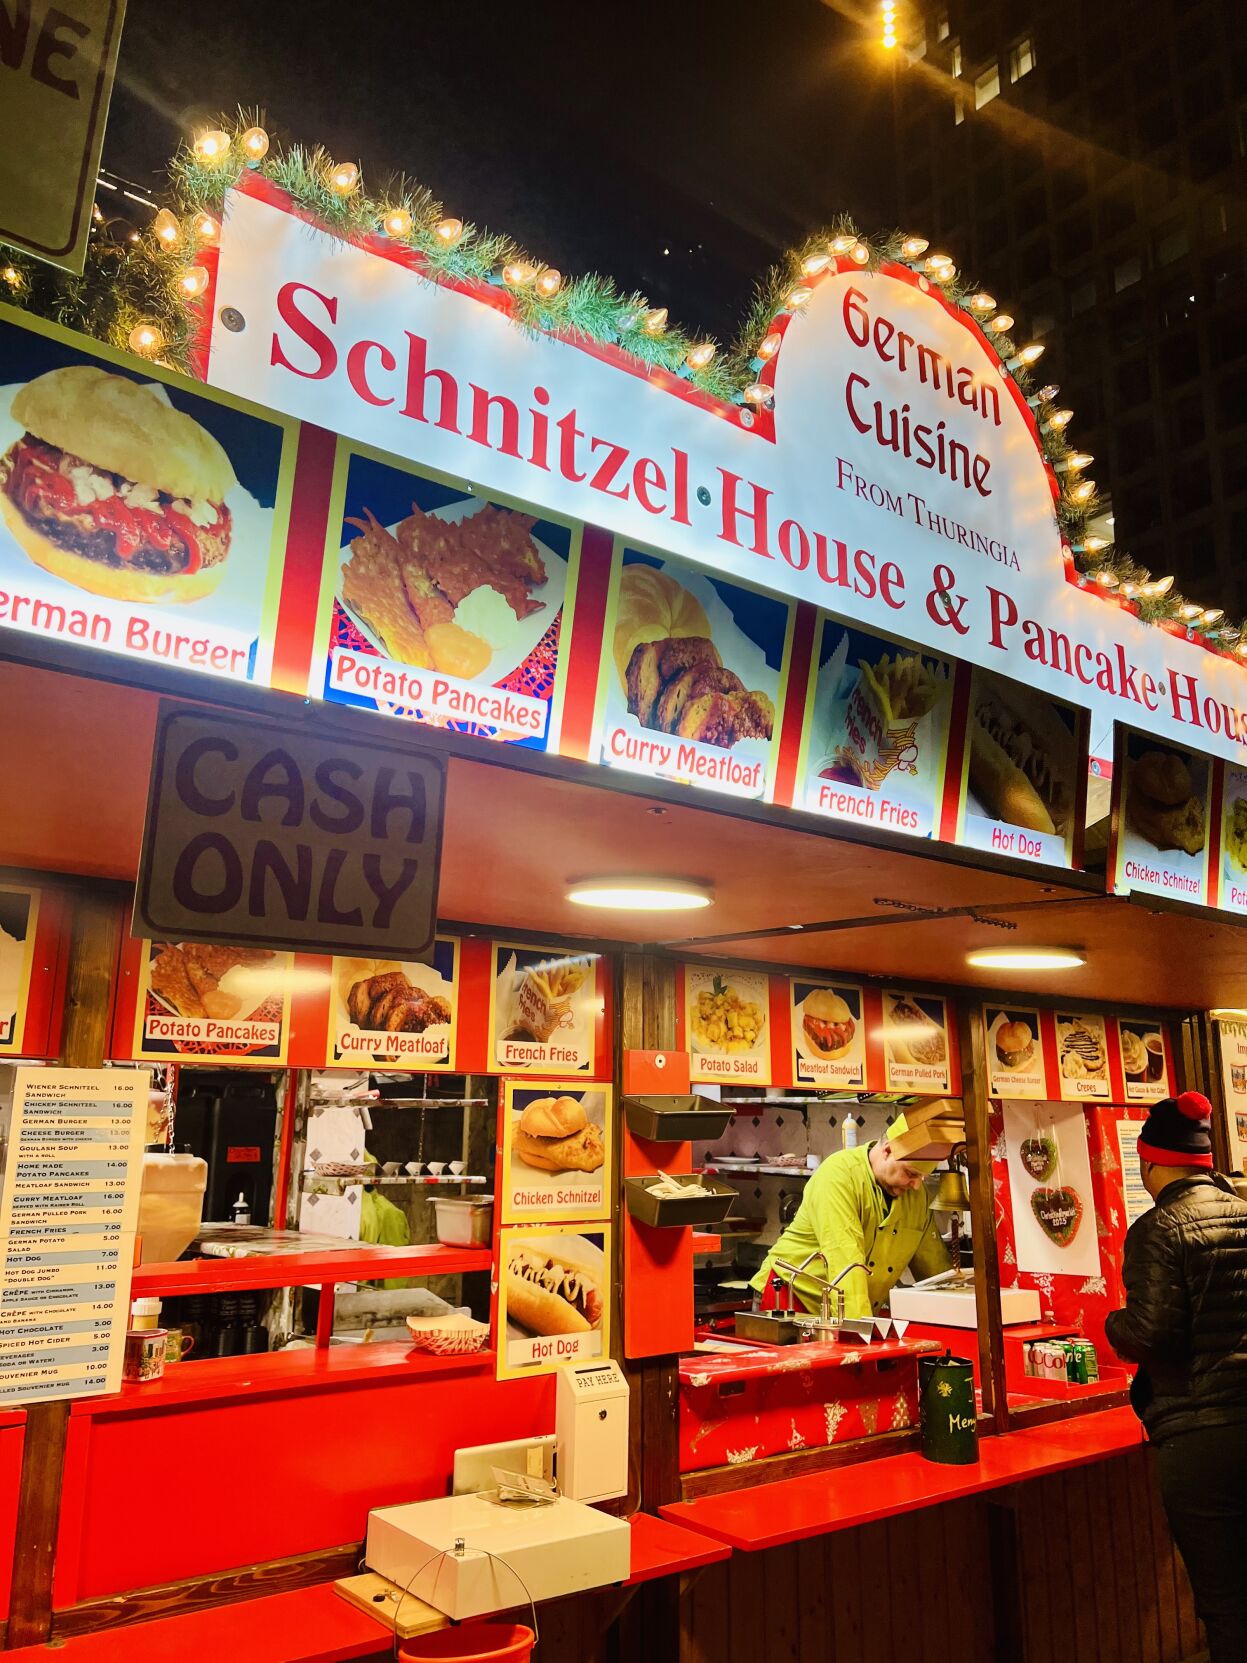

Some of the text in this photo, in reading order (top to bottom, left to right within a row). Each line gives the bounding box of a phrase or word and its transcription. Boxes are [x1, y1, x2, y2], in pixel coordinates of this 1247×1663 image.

[842, 286, 1002, 427] German
[845, 372, 992, 498] Cuisine
[270, 281, 693, 527] Schnitzel
[716, 466, 906, 610] House
[926, 564, 970, 635] &
[985, 585, 1160, 712] Pancake
[835, 457, 1021, 572] FROM THURINGIA
[125, 616, 245, 674] Burger
[336, 656, 542, 731] Potato Pancakes
[611, 727, 761, 788] Curry Meatloaf
[175, 736, 427, 844] CASH
[819, 785, 919, 829] French Fries
[992, 827, 1042, 858] Hot Dog
[172, 831, 418, 929] ONLY
[1125, 861, 1201, 894] Chicken Schnitzel
[148, 1019, 276, 1041] Potato Pancakes
[340, 1032, 445, 1054] Curry Meatloaf
[505, 1045, 578, 1062] French Fries
[700, 1057, 758, 1073] Potato Salad
[800, 1062, 860, 1076] Meatloaf Sandwich
[890, 1066, 945, 1079] German Pulled Pork
[1076, 1081, 1097, 1093] Crepes
[513, 1188, 600, 1206] Chicken Schnitzel
[0, 1310, 27, 1318] CRÊPE
[17, 1325, 64, 1334] CHOCOLATE
[532, 1339, 579, 1358] Hot Dog
[17, 1383, 55, 1391] SOUVENIER
[576, 1373, 620, 1388] PAY HERE
